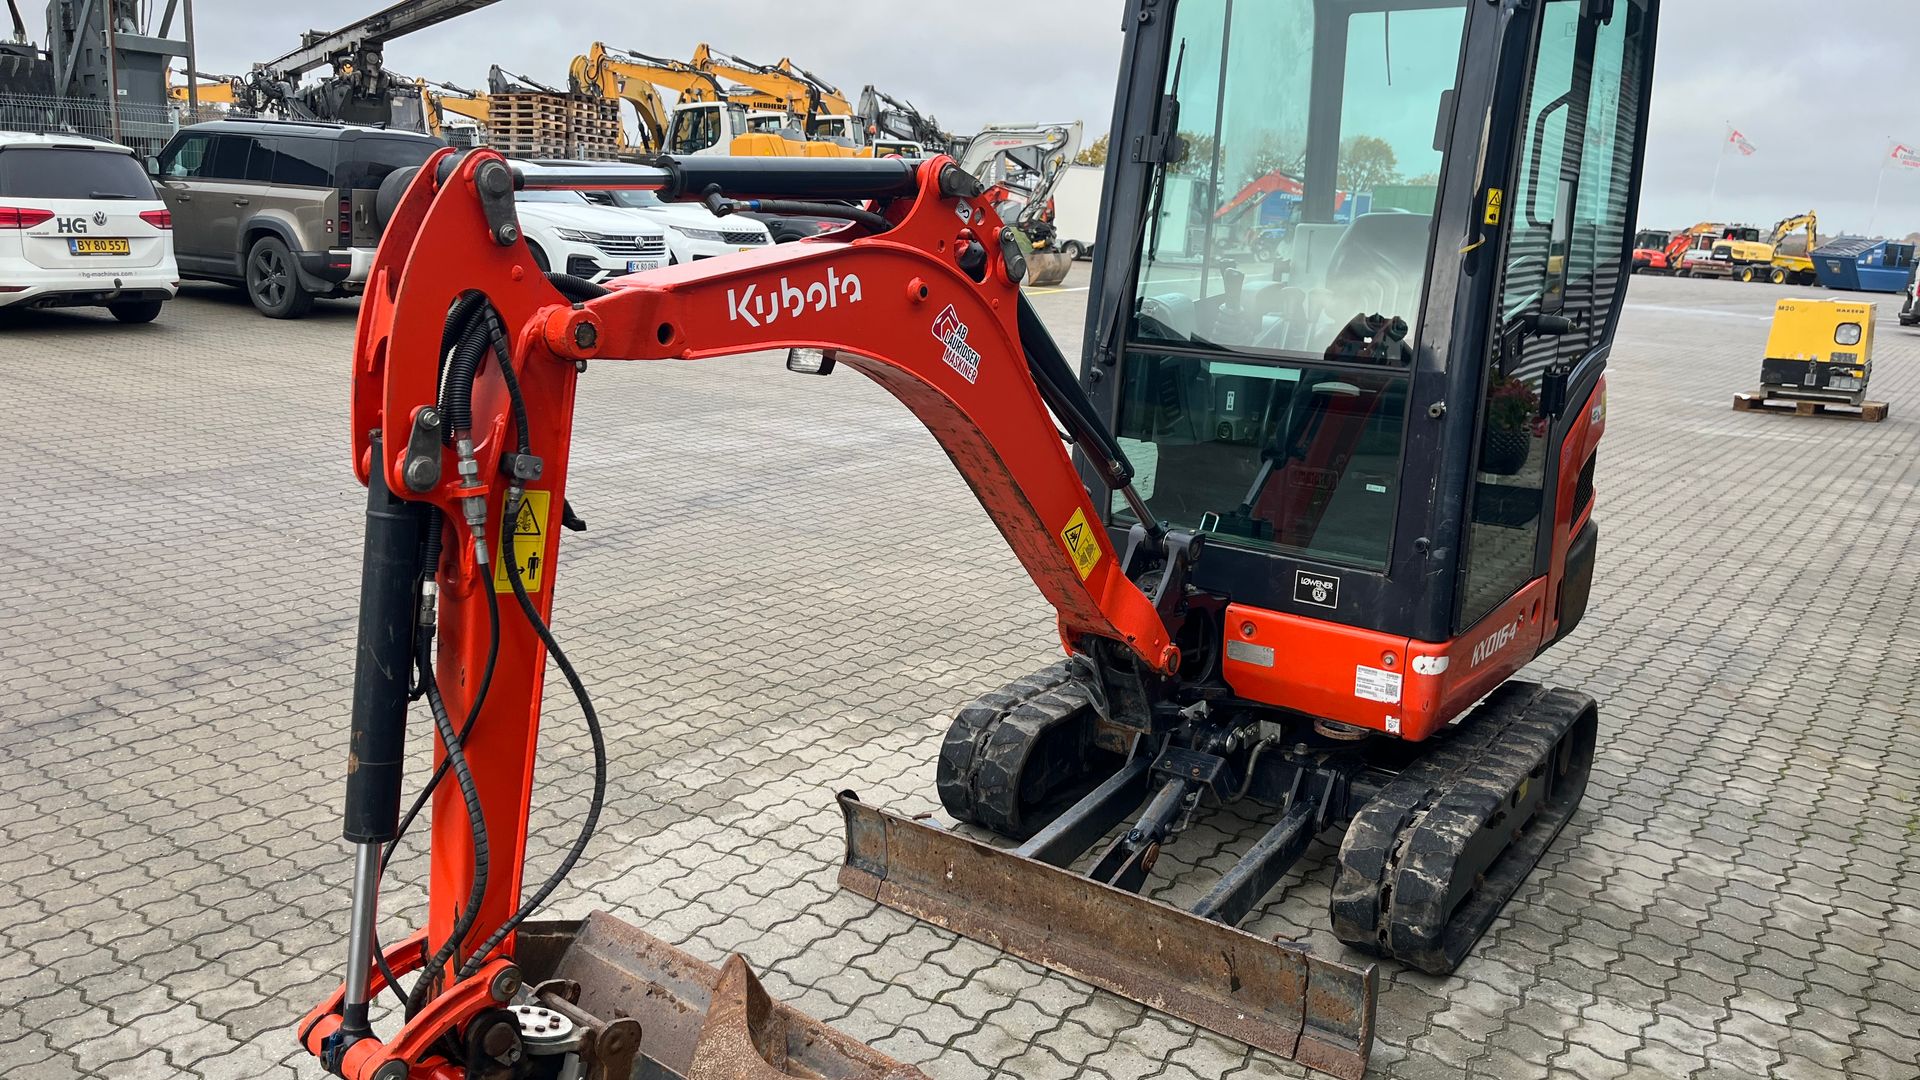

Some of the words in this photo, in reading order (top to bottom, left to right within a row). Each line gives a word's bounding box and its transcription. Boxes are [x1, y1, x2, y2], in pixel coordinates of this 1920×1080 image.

[753, 102, 788, 110] LIEBHERR
[57, 217, 88, 233] HG
[77, 240, 92, 251] BY
[93, 240, 107, 251] 80
[108, 240, 127, 251] 557
[727, 267, 862, 327] Kubota
[956, 324, 968, 340] AB
[944, 330, 980, 367] LAURIDSEN
[944, 347, 978, 382] MASKINER
